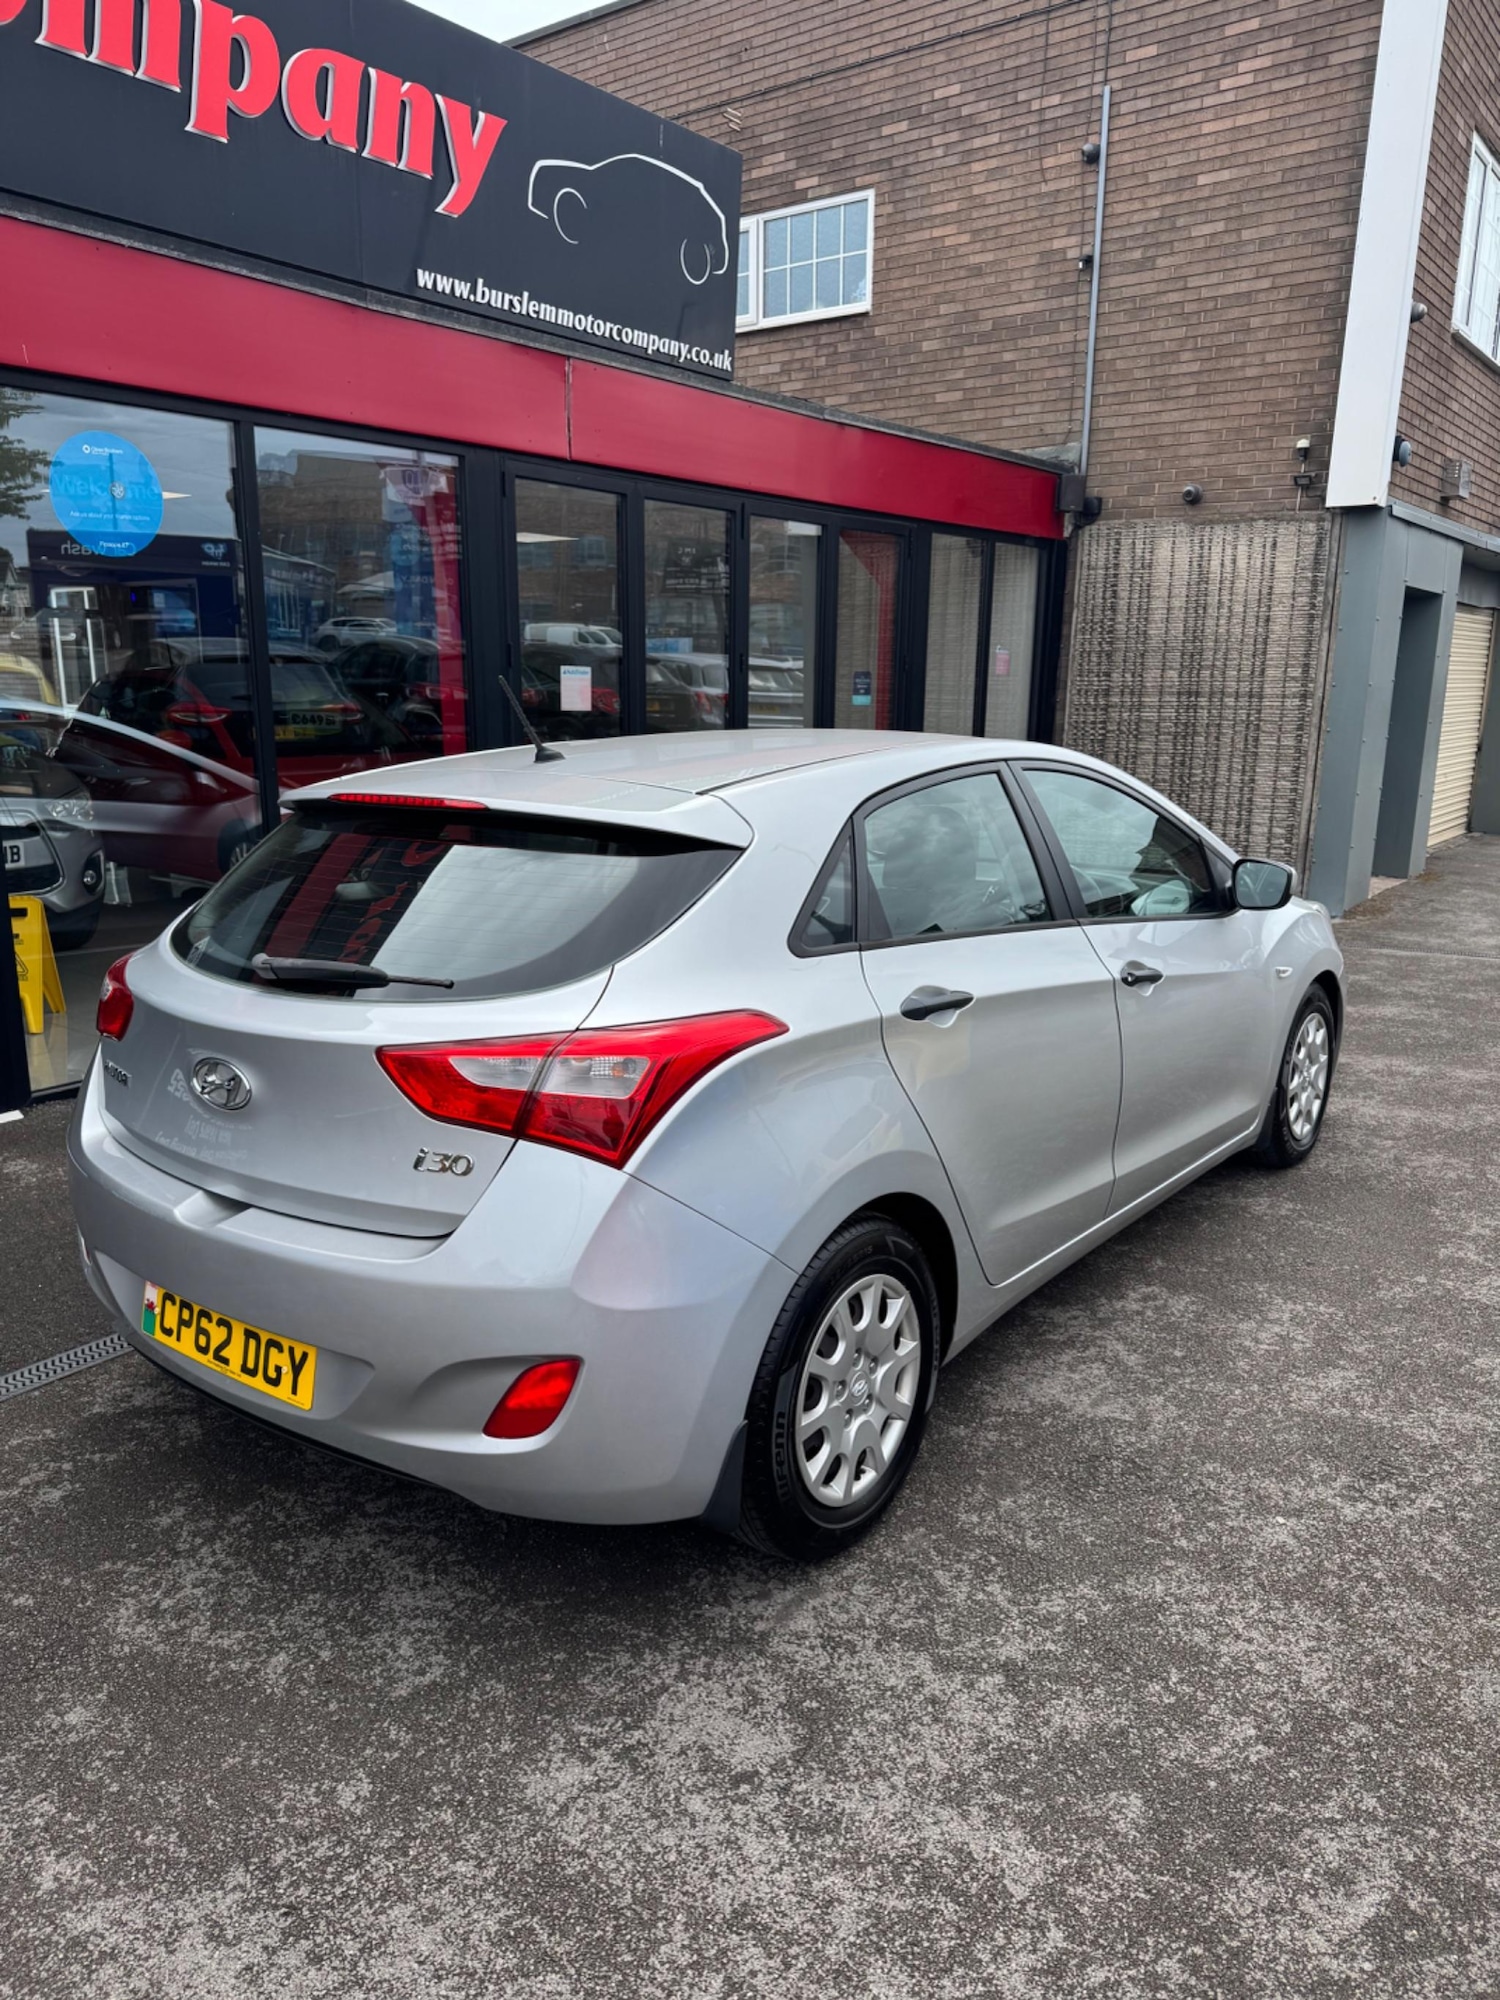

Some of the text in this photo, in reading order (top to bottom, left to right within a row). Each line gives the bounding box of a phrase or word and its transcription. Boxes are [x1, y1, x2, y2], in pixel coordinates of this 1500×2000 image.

[0, 0, 508, 218] mpany
[416, 267, 733, 373] www.burslemmotorcompany.co.uk
[412, 1146, 476, 1177] i30
[159, 1291, 309, 1397] CP62 DGY
